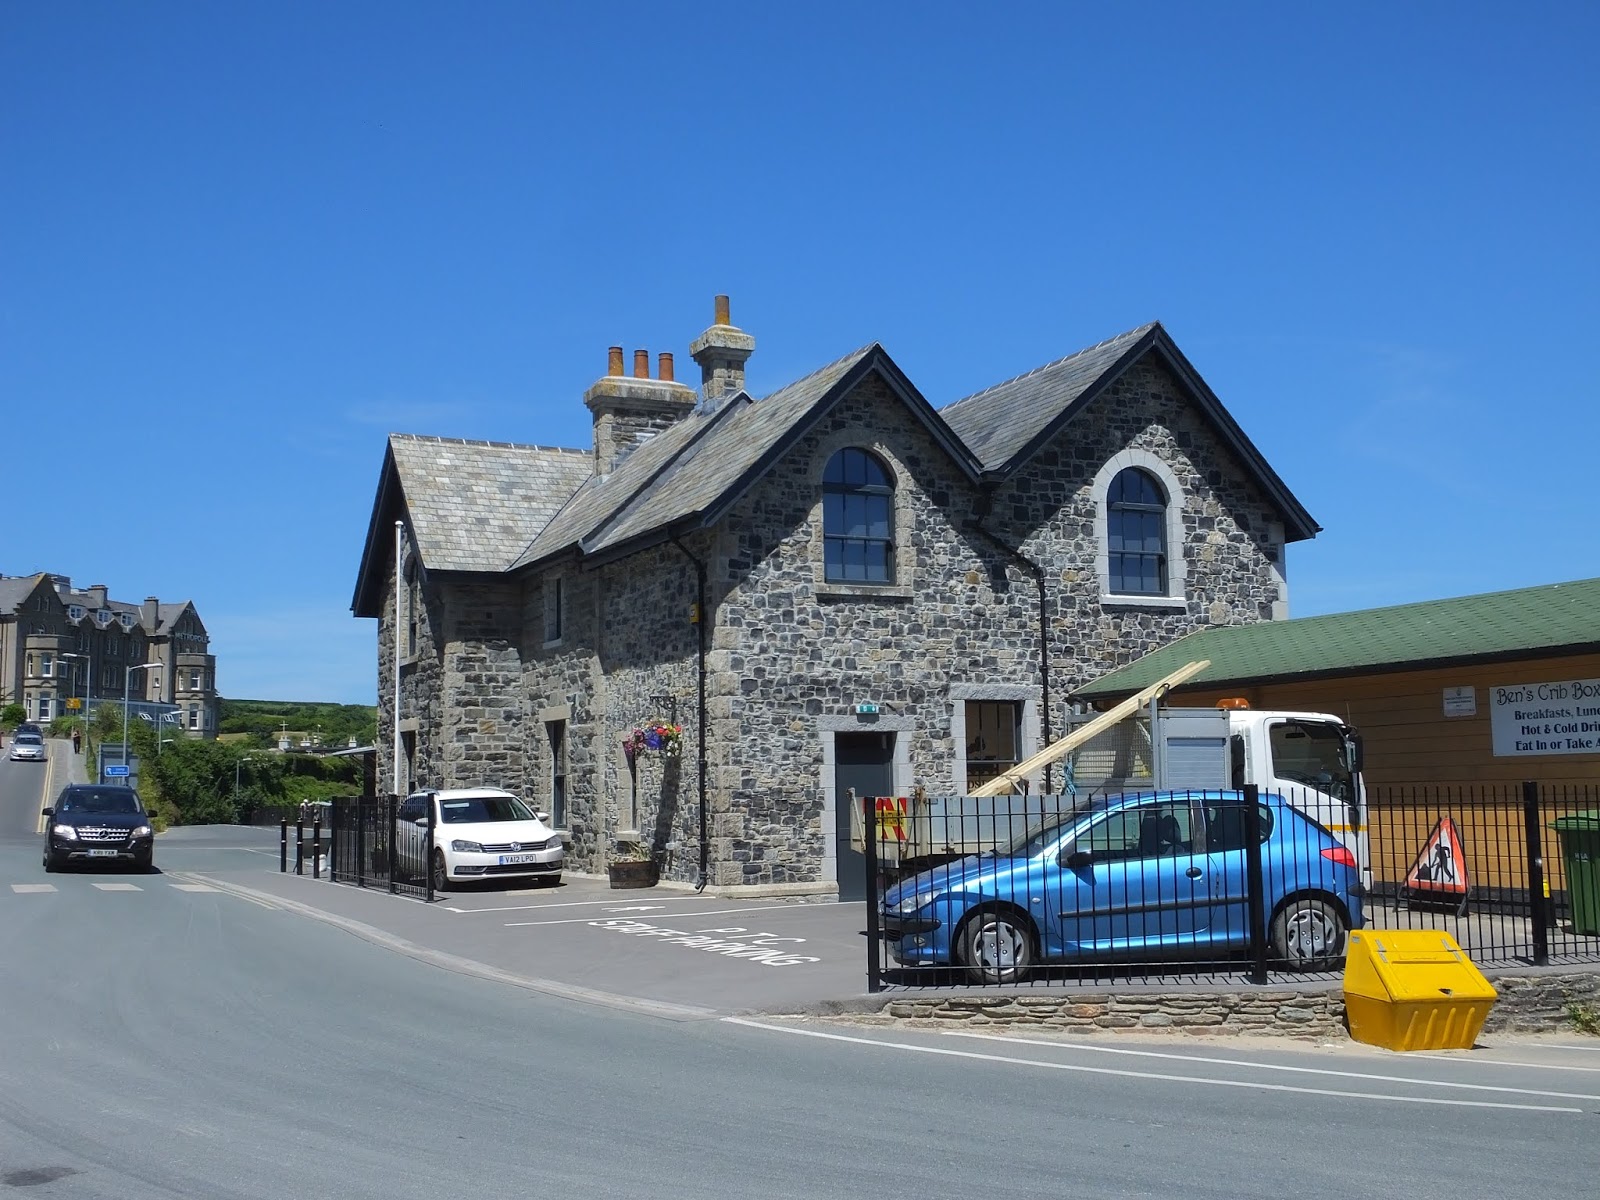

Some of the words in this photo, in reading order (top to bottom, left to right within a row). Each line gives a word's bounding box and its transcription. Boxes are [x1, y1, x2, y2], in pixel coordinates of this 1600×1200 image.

[1496, 686, 1534, 706] Ben's
[1537, 683, 1568, 701] Crib
[1571, 682, 1600, 700] Box
[1514, 708, 1574, 721] Breakfasts,
[1521, 725, 1542, 736] Hot
[1544, 724, 1551, 735] &
[1553, 723, 1578, 735] Cold
[1515, 740, 1533, 751] Eat
[1536, 740, 1547, 750] In
[1550, 741, 1562, 750] or
[1565, 738, 1592, 749] Take
[588, 920, 692, 937] STAFF
[658, 935, 821, 967] PARKING
